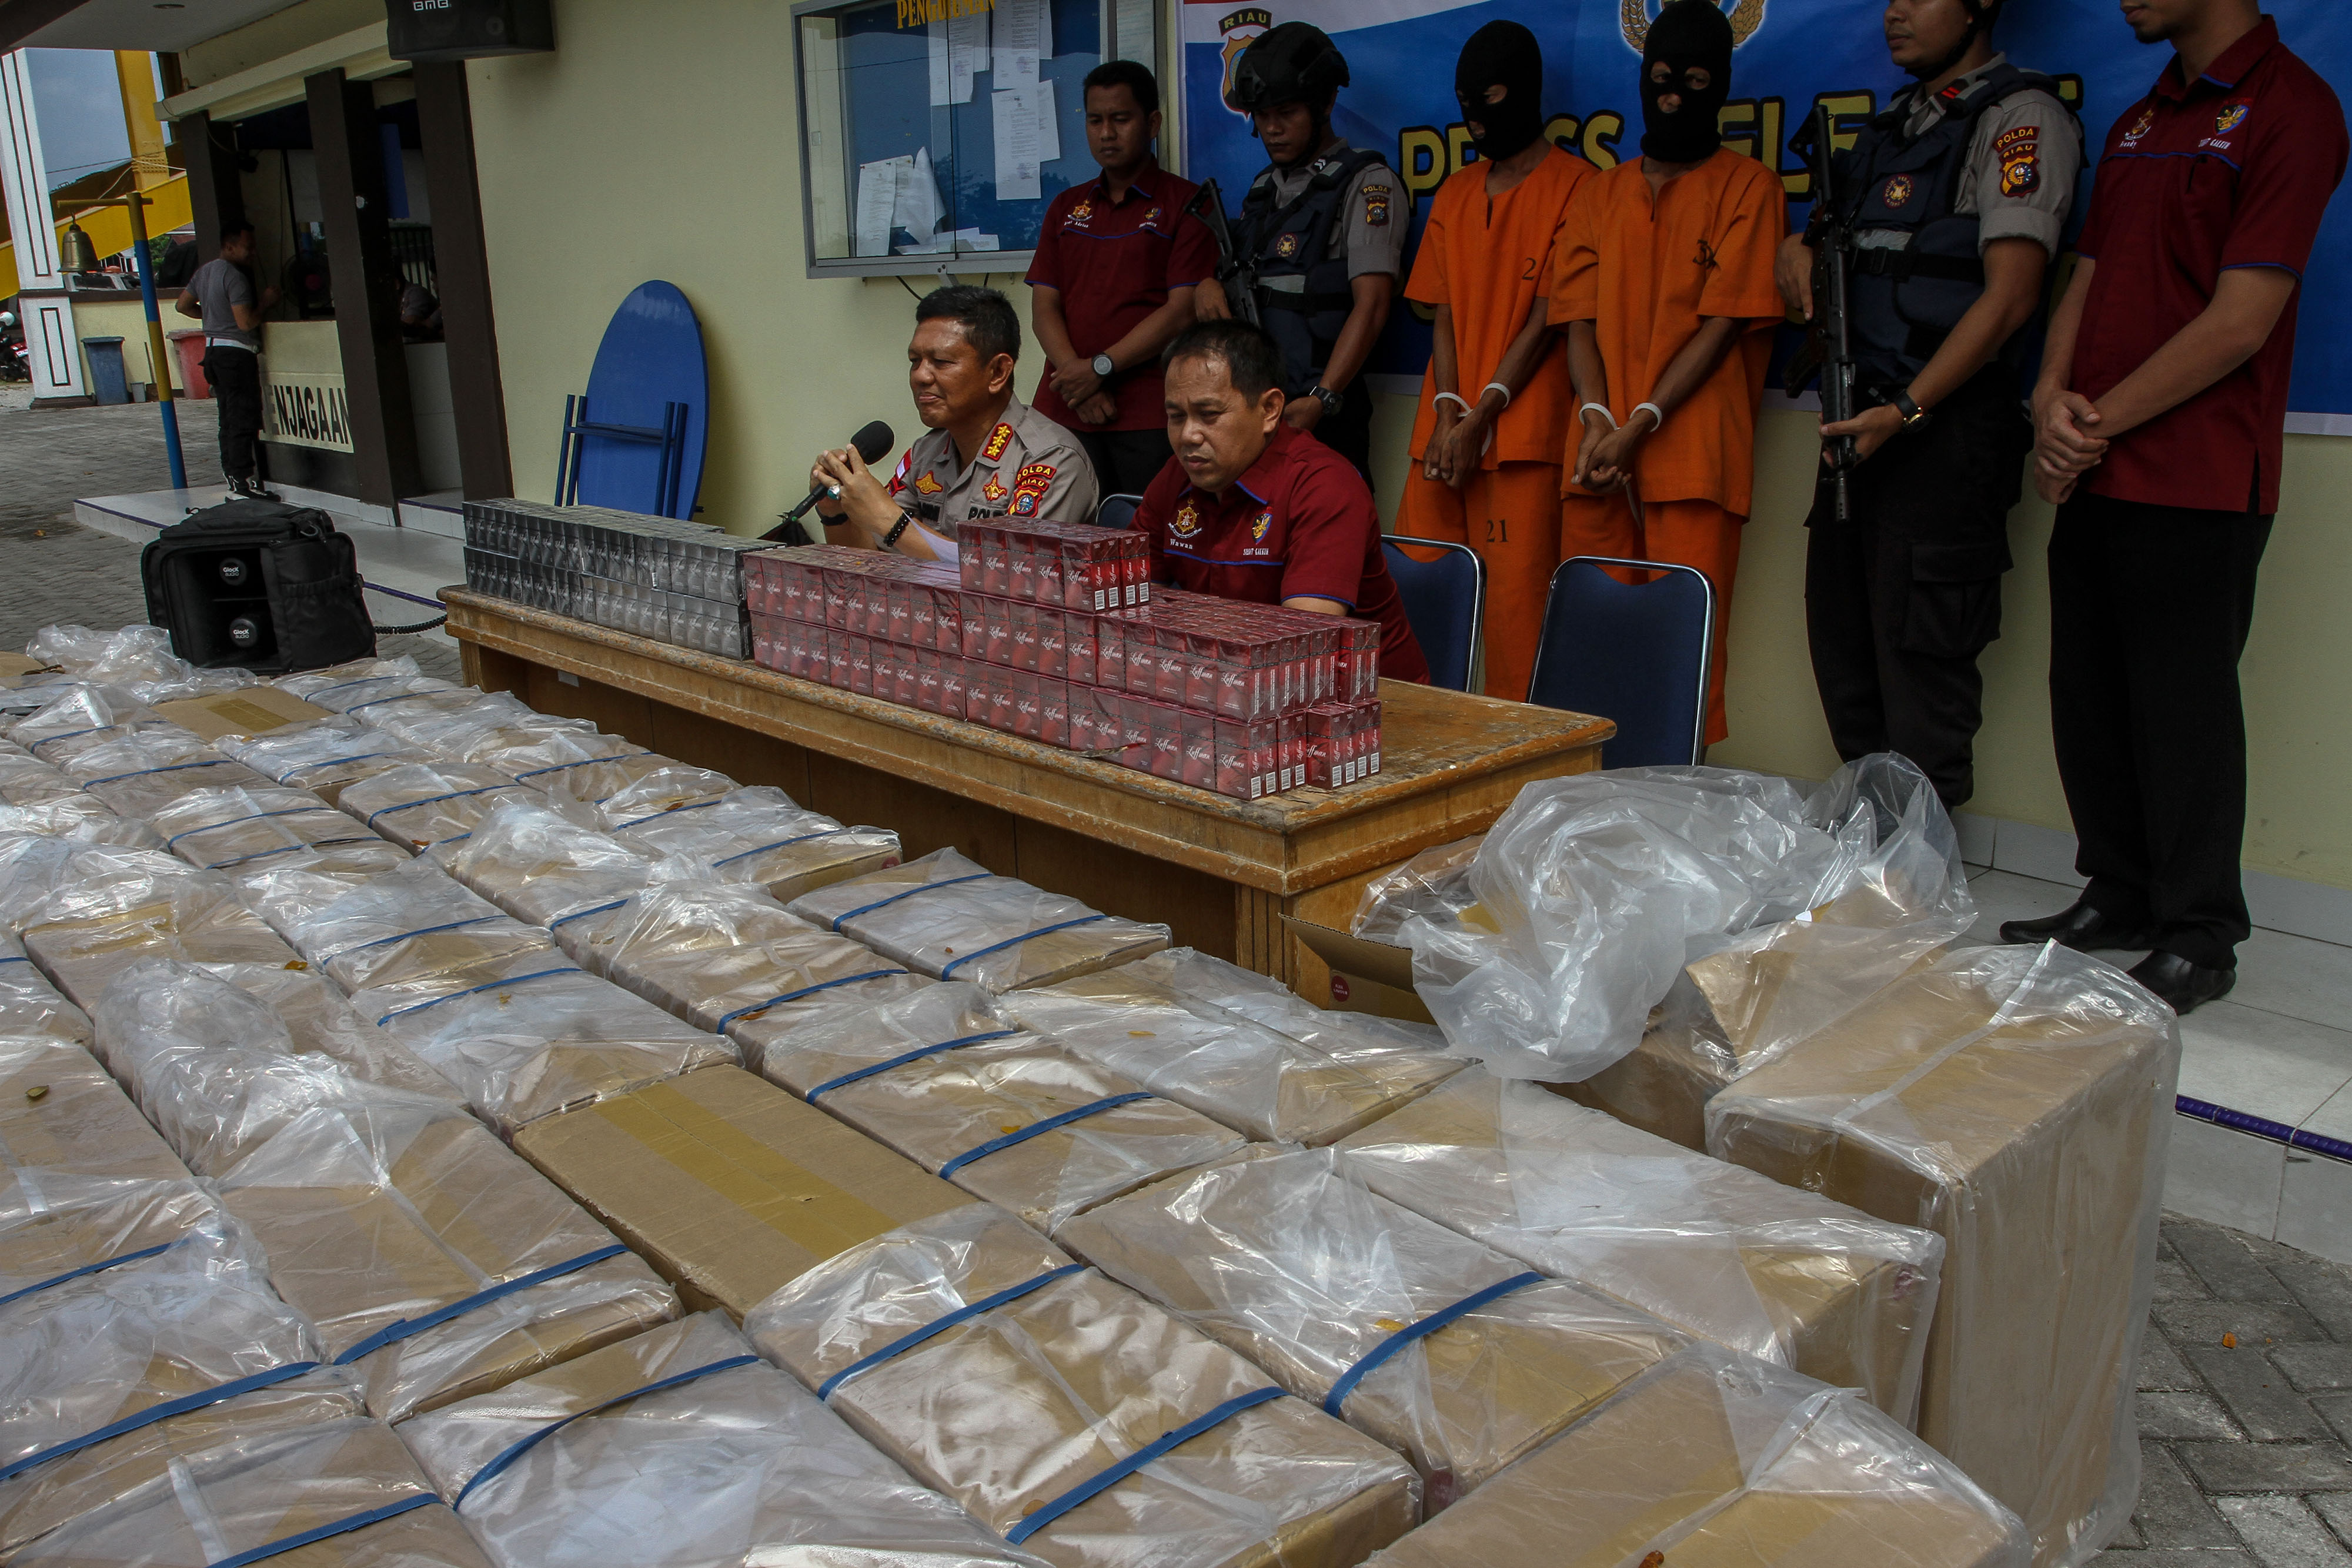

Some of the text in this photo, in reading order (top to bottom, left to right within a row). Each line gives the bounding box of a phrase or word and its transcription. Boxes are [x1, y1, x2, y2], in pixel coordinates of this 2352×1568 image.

[1224, 12, 1267, 29] RIAU
[1997, 128, 2034, 148] POLDA
[2003, 145, 2033, 158] RIAU
[1363, 185, 1388, 194] POLDA
[260, 385, 351, 444] ENJAGAAN
[1017, 466, 1051, 481] POLDA
[1021, 478, 1045, 487] RIAU
[1486, 520, 1508, 542] 21
[1170, 539, 1194, 550] Wawan
